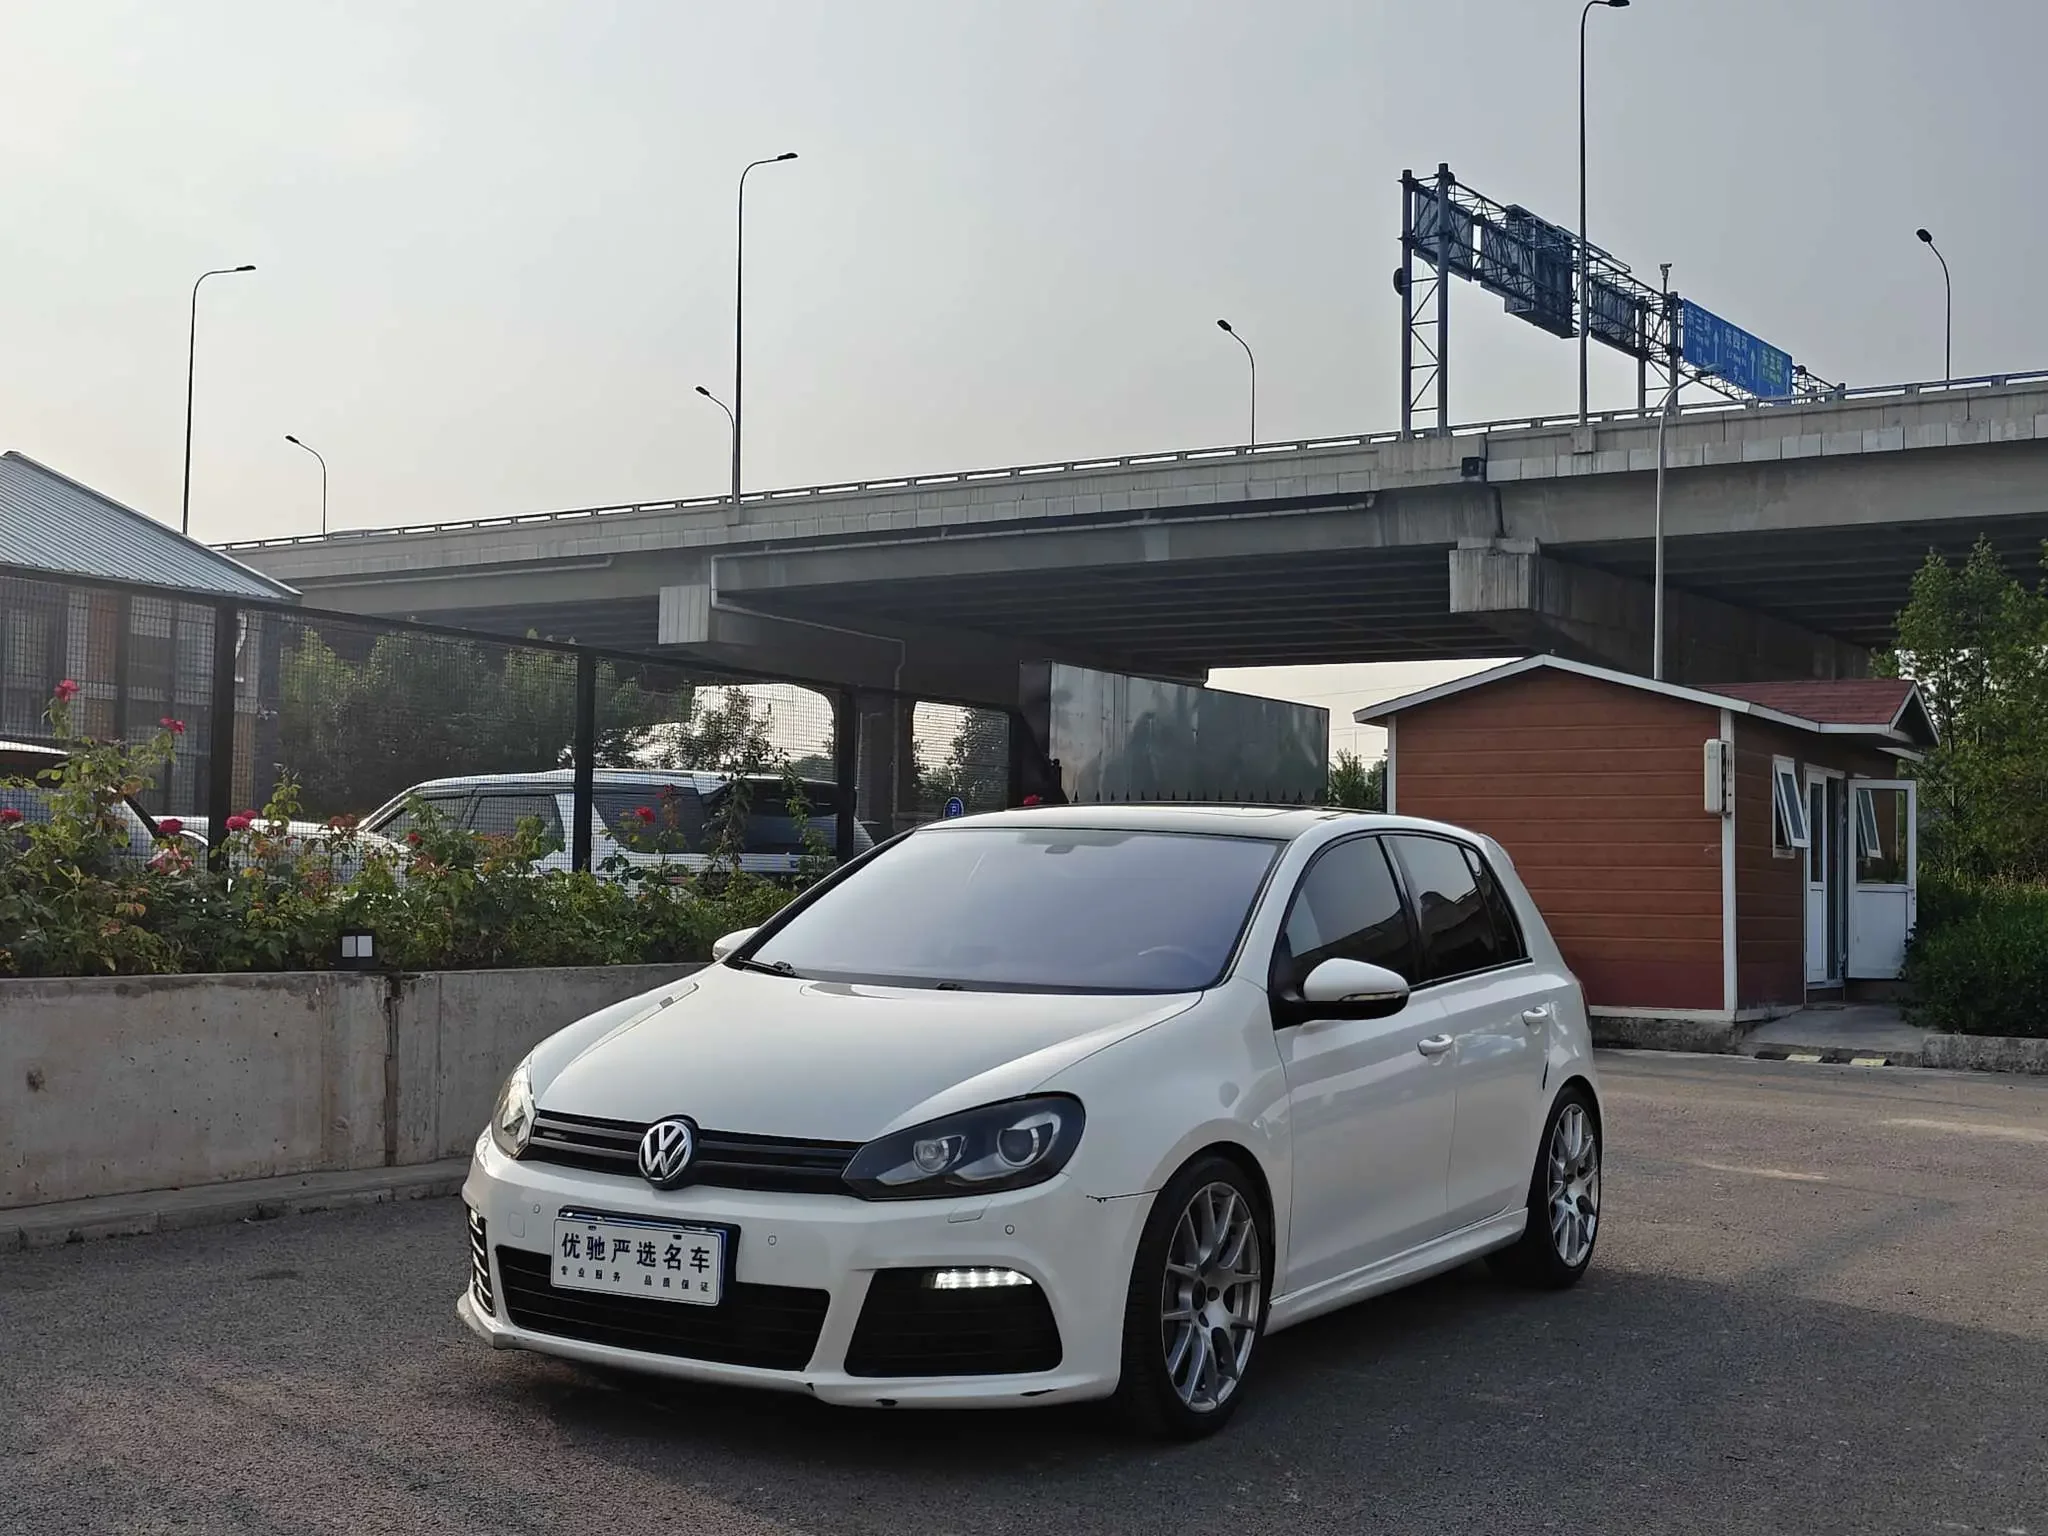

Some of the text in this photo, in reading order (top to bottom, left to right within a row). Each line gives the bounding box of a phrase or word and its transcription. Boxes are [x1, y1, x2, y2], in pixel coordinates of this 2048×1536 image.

[641, 1122, 690, 1180] VW
[561, 1232, 710, 1273] 优驰严选名车
[561, 1265, 709, 1292] 专业服务 品质保证
